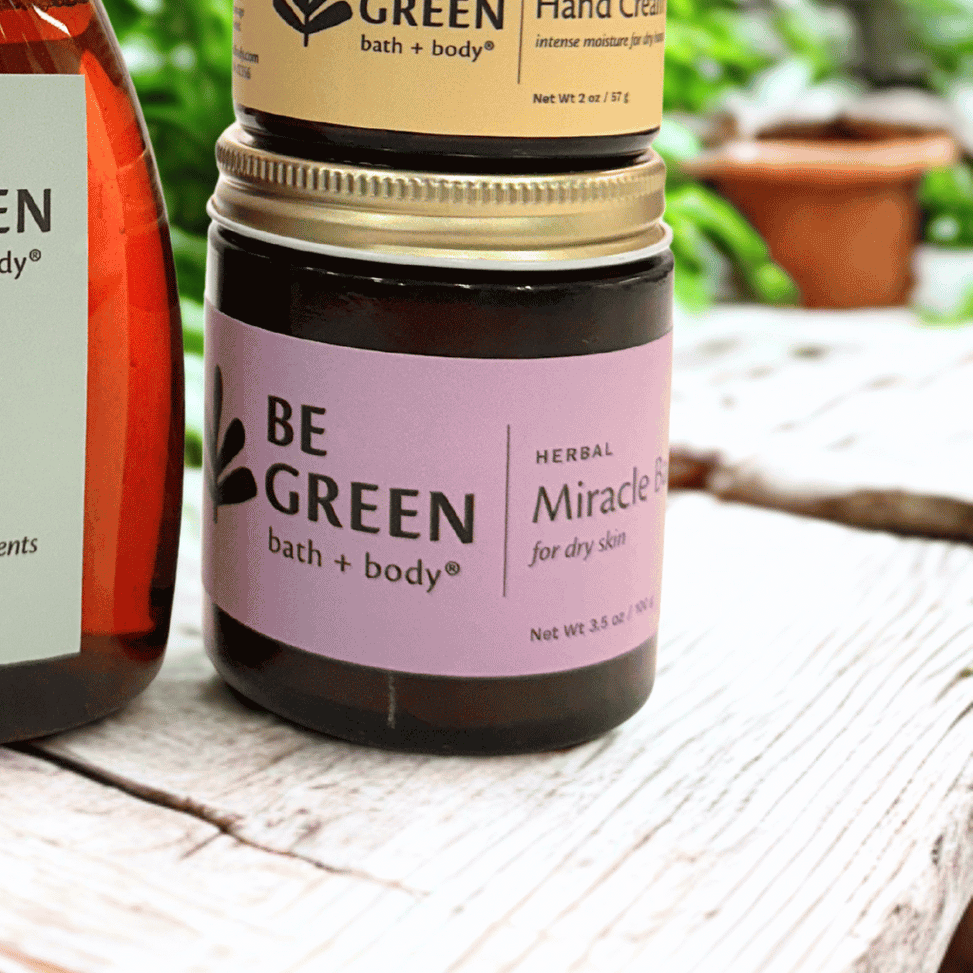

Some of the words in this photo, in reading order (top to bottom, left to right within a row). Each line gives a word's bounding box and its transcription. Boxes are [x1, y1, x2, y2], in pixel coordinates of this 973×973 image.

[360, 34, 402, 54] bath
[411, 41, 424, 55] +
[535, 33, 580, 48] intense
[583, 33, 629, 48] moisture
[533, 93, 555, 104] Net
[558, 93, 575, 104] Wt
[578, 93, 586, 104] 2
[588, 93, 601, 103] oz
[611, 91, 623, 103] 57
[267, 395, 327, 457] BE
[536, 442, 613, 465] HERBAL
[264, 463, 475, 545] GREEN
[532, 466, 650, 524] Miracle
[268, 527, 323, 567] bath
[335, 556, 352, 573] +
[528, 540, 561, 568] for
[564, 537, 595, 561] dry
[598, 528, 627, 553] skin
[530, 627, 559, 642] Net
[563, 622, 585, 638] Wt
[589, 615, 609, 633] 3.5
[611, 612, 625, 627] oz
